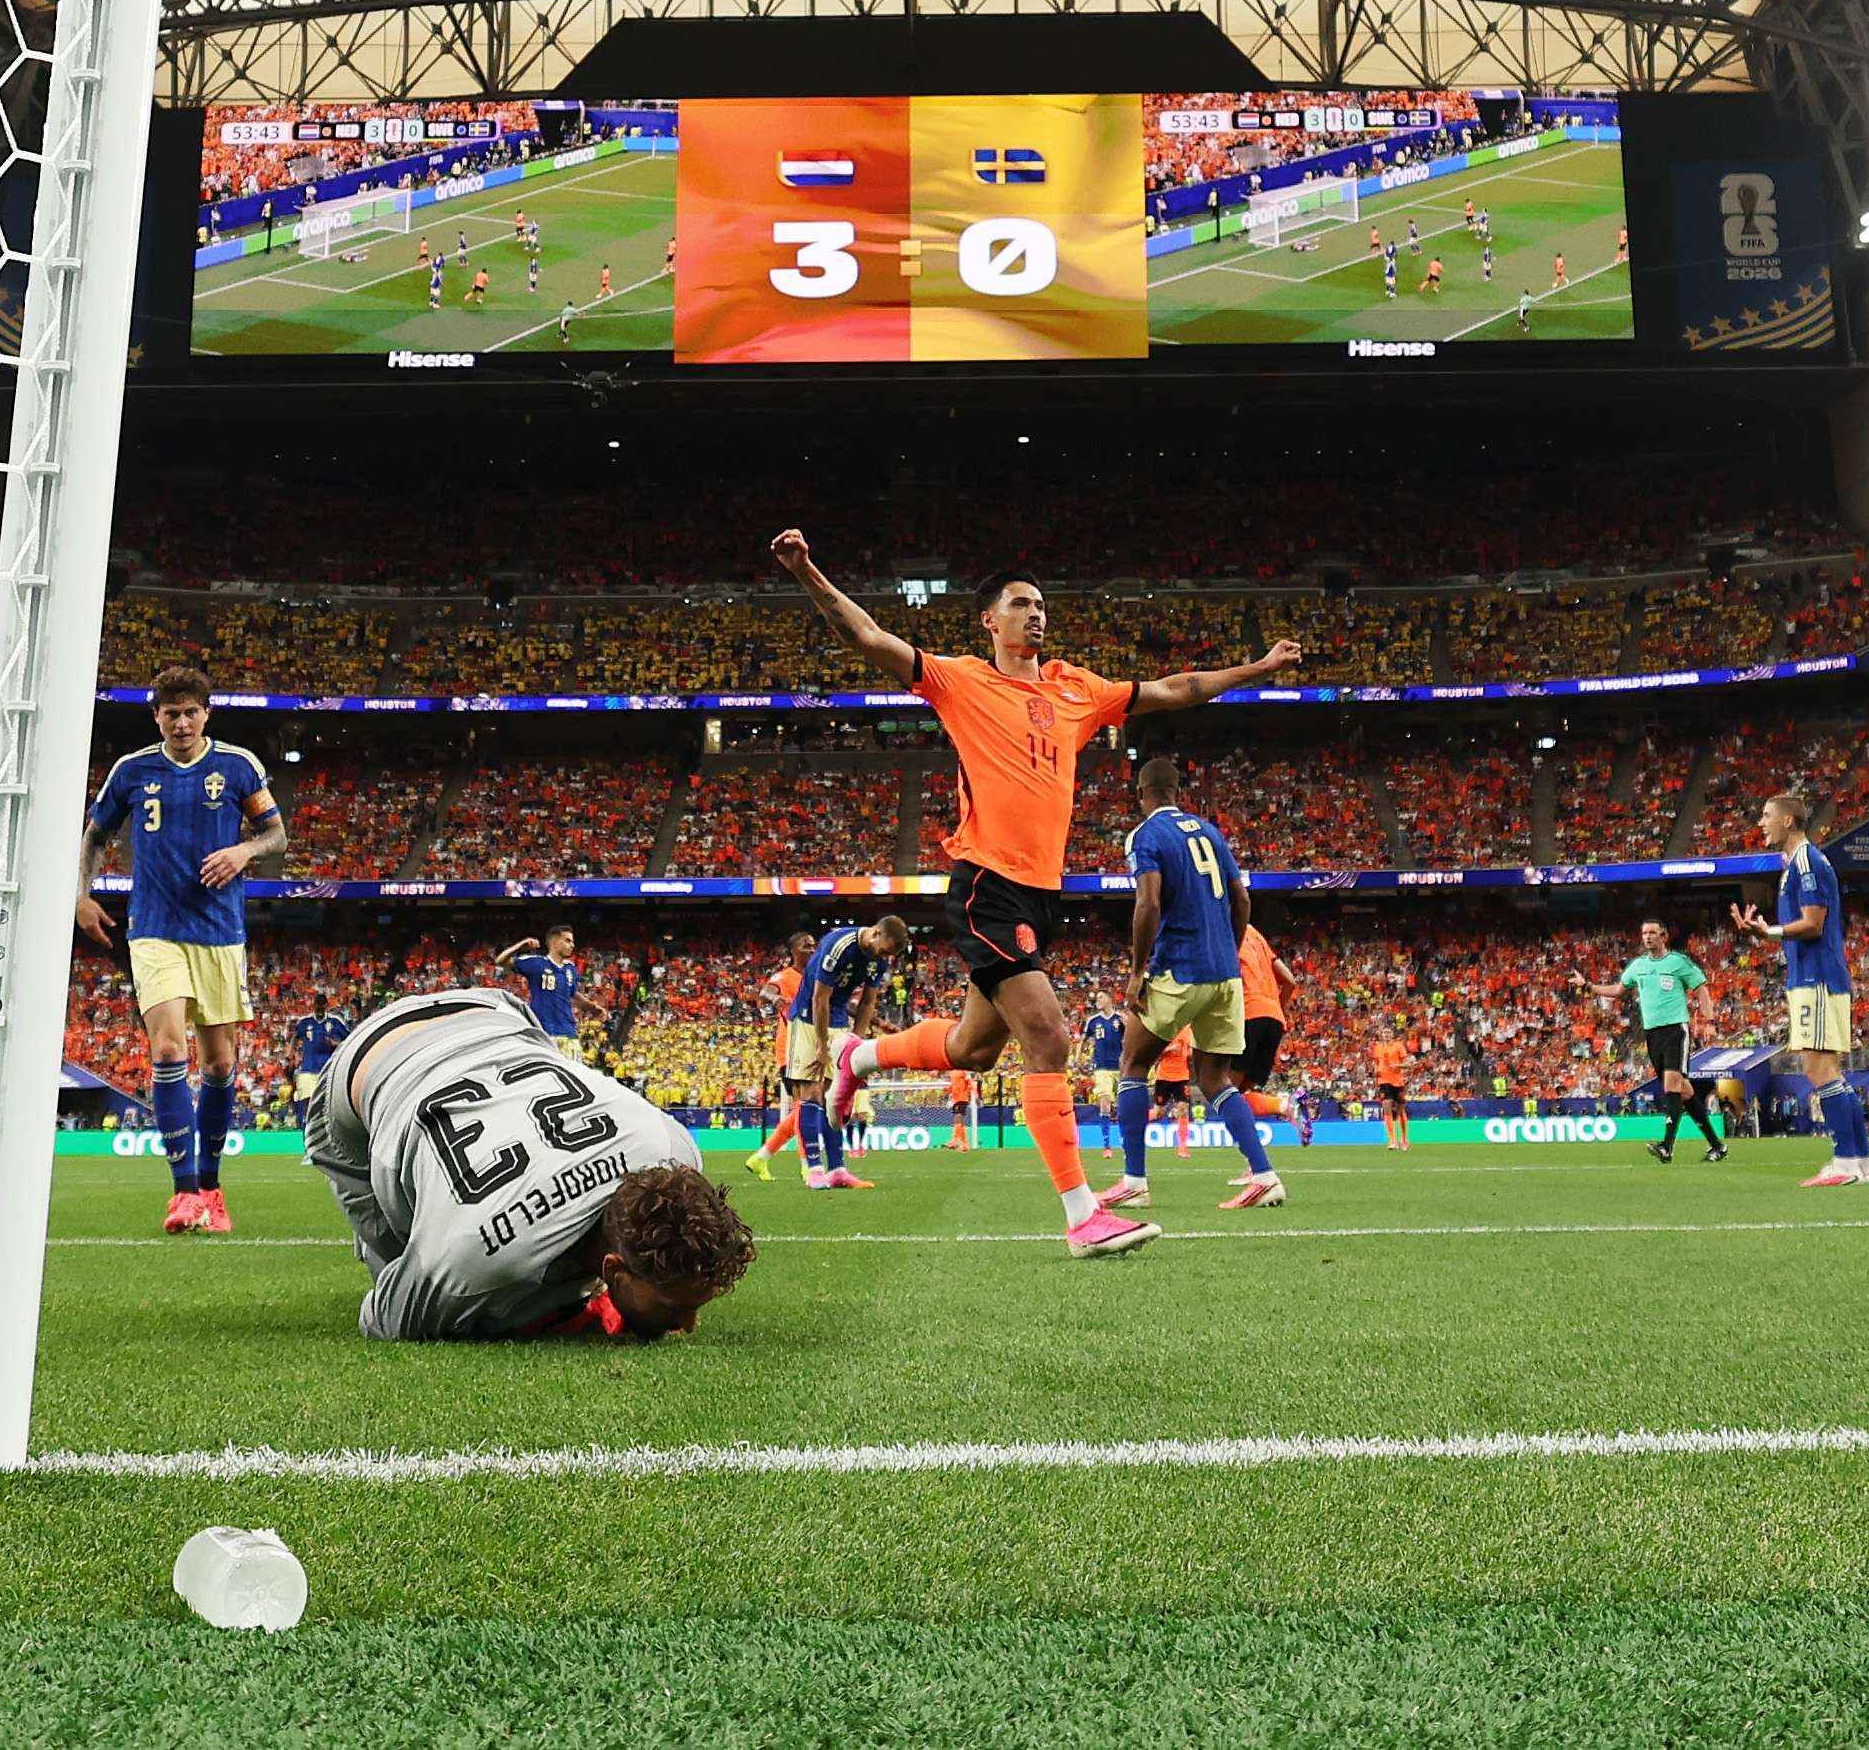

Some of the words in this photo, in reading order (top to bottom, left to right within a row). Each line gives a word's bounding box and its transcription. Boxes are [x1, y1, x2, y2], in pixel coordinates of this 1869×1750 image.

[1171, 114, 1220, 129] 53:43
[1310, 113, 1320, 127] 3
[1349, 113, 1359, 127] 0
[232, 125, 280, 141] 53:43
[369, 125, 380, 139] 3
[408, 125, 418, 139] 0
[1381, 164, 1430, 190] aramco
[435, 175, 485, 201] aramco
[1740, 238, 1765, 248] FIFA
[768, 220, 860, 298] 3
[957, 215, 1059, 297] 0
[1347, 337, 1437, 358] Hisense
[387, 349, 475, 369] Hisense
[1796, 656, 1849, 674] HOUSTON
[1578, 679, 1603, 692] FIFA
[1603, 676, 1641, 692] WORLD
[1641, 674, 1662, 689] CUP
[719, 696, 772, 707] HOUSTON
[1432, 687, 1484, 699] HOUSTON
[363, 699, 417, 711] HOUSTON
[1026, 732, 1059, 775] 14
[143, 799, 162, 833] 3
[1186, 836, 1225, 901] 4
[870, 876, 891, 895] 3
[1397, 872, 1464, 885] HOUSTON
[379, 883, 446, 896] HOUSTON
[1799, 1004, 1812, 1027] 2
[414, 1059, 619, 1205] 23
[1485, 1116, 1617, 1143] aramco
